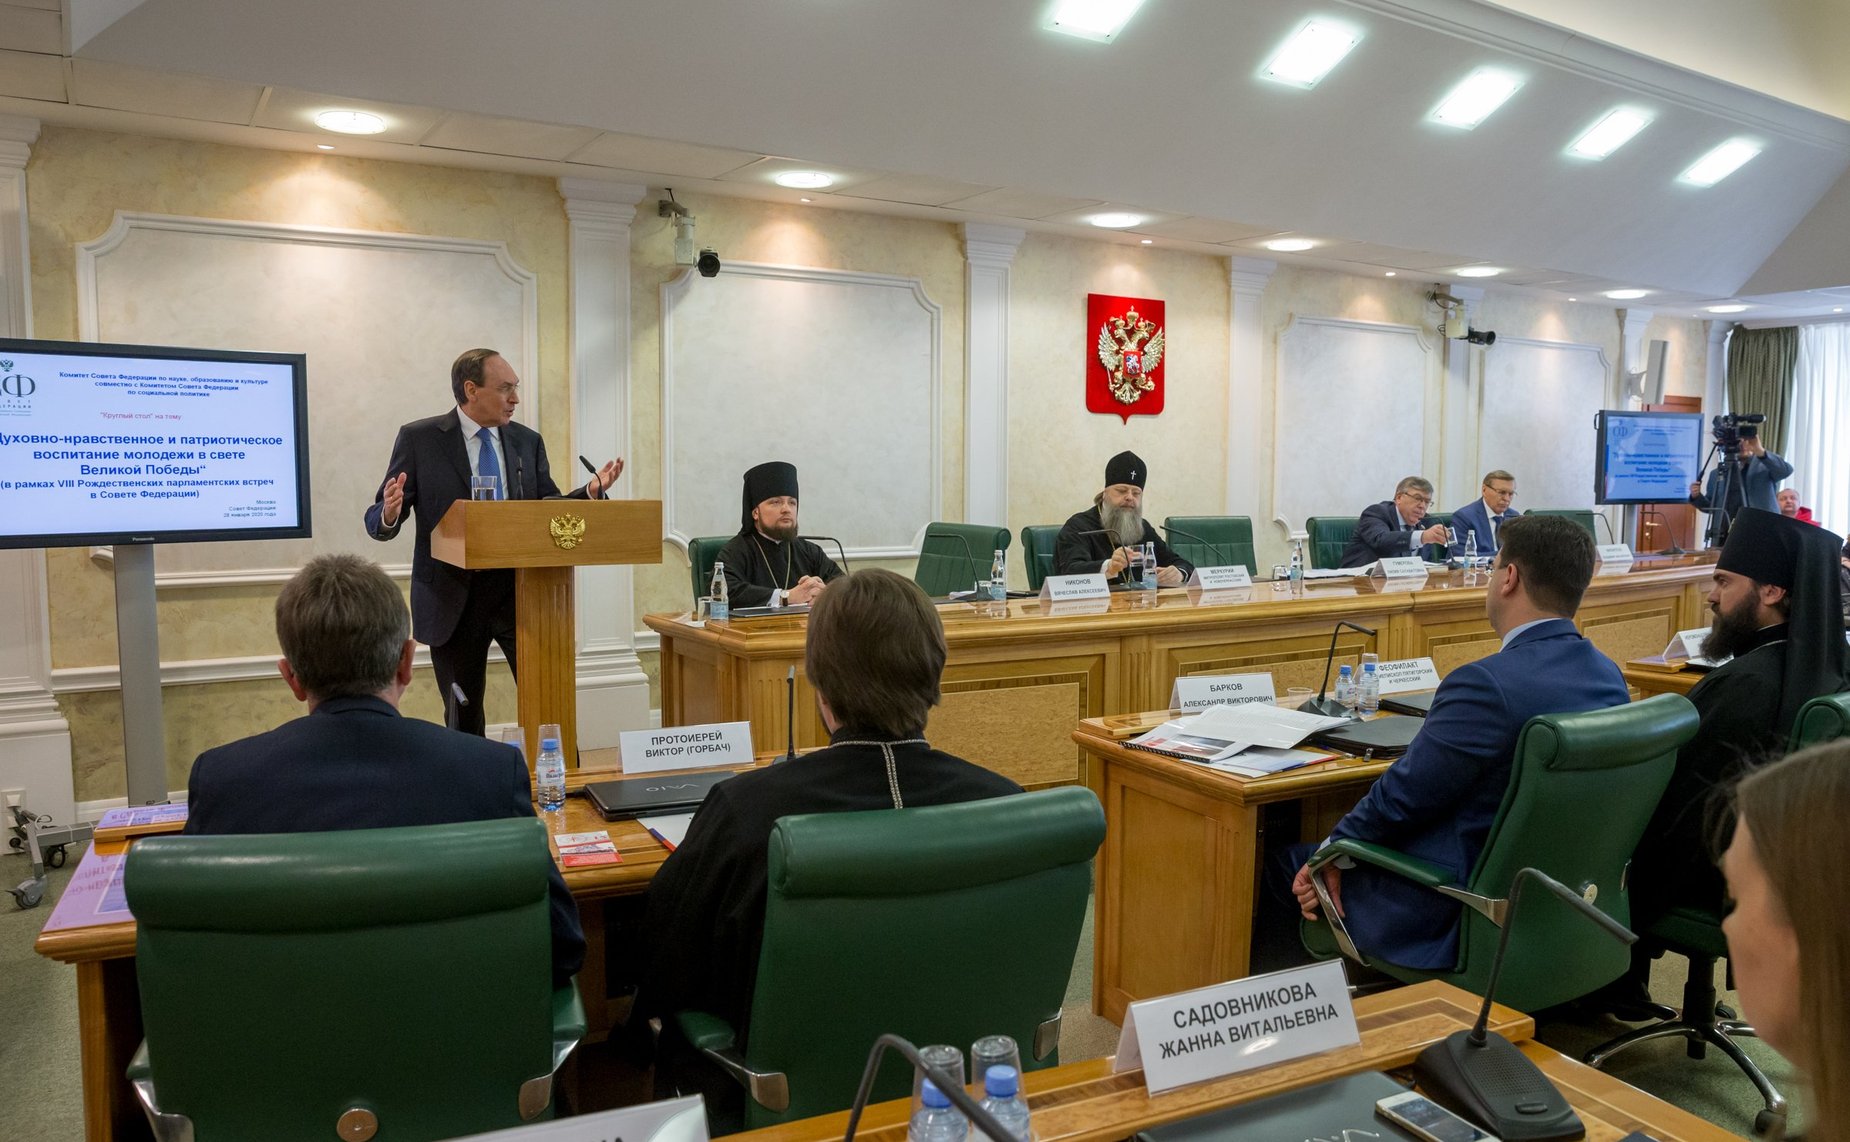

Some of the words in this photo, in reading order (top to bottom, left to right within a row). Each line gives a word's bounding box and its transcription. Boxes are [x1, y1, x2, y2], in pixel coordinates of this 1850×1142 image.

[118, 374, 157, 382] Федерации
[203, 384, 239, 392] Федерации
[100, 412, 133, 420] "Круглый
[168, 436, 176, 445] и
[180, 436, 283, 447] патриотическое
[33, 451, 120, 460] воспитание
[124, 451, 194, 461] молодежи
[198, 451, 206, 460] в
[210, 451, 246, 460] свете
[80, 464, 142, 475] Великой
[0, 480, 12, 490] (в
[15, 481, 55, 490] рамках
[57, 479, 75, 488] VIII
[77, 479, 163, 489] Рождественских
[166, 479, 240, 489] парламентских
[242, 479, 274, 487] встреч
[100, 490, 137, 499] Совете
[140, 490, 200, 500] Федерации)
[1064, 578, 1091, 586] НИКОНОВ
[1379, 661, 1419, 671] ФЕОФИЛАКТ
[1403, 668, 1433, 677] ПЯТИГОРСКИЙ
[1209, 683, 1243, 692] БАРКОВ
[1183, 698, 1226, 708] АЛЕКСАНДР
[1226, 695, 1273, 705] ВИКТОРОВИЧ
[651, 730, 723, 746] ПРОТОИЕРЕЙ
[645, 747, 684, 758] ВИКТОР
[686, 743, 731, 756] (ГОРБАЧ)
[1173, 982, 1317, 1029] САДОВНИКОВА
[1159, 1031, 1226, 1060] ЖАННА
[1228, 1003, 1339, 1043] ВИТАЛЬЕВНА
